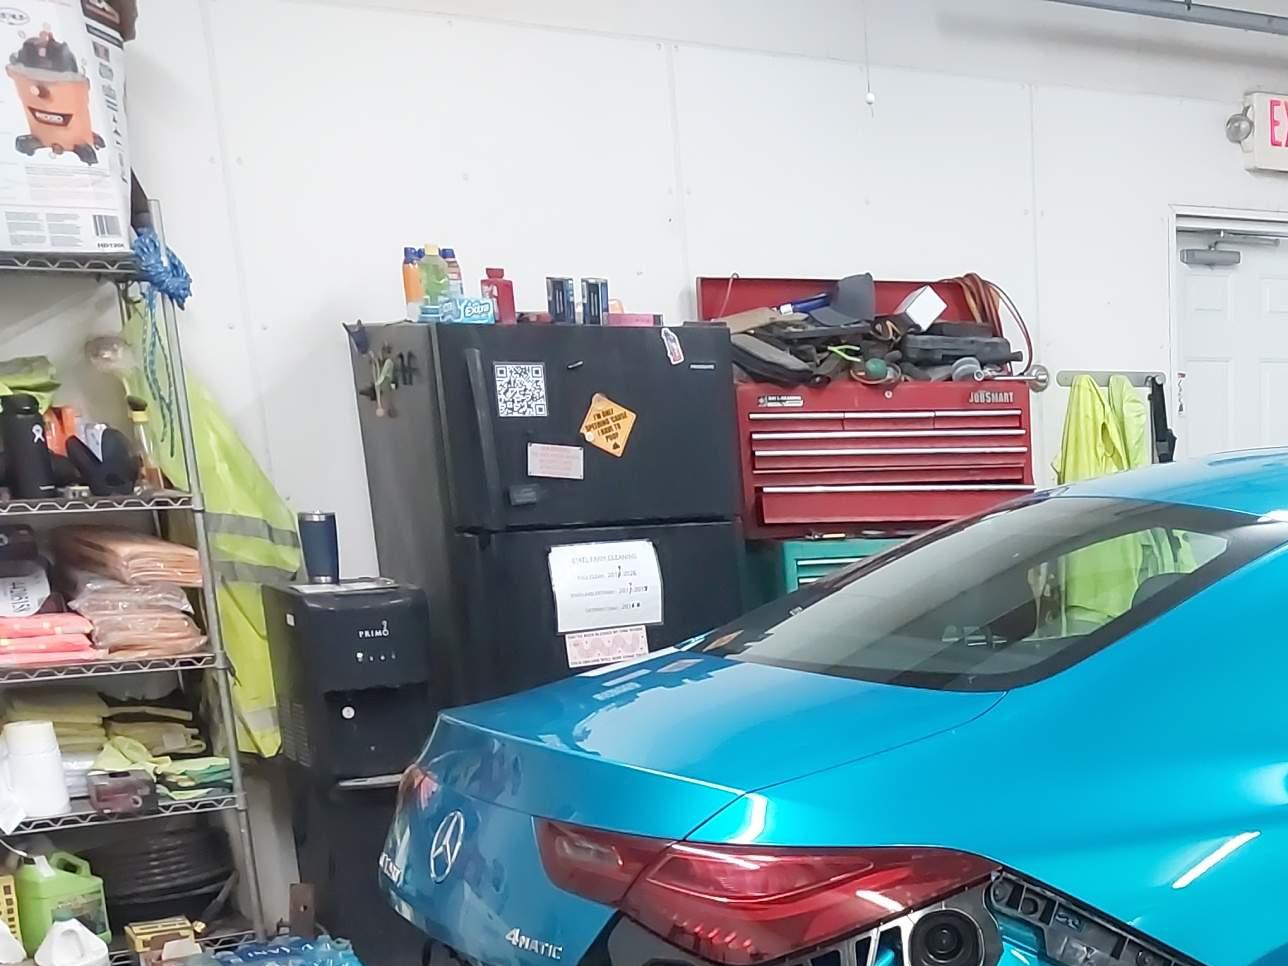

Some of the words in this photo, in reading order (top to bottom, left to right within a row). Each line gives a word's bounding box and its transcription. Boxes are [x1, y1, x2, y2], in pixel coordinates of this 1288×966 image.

[969, 391, 1014, 403] JOBSMART
[358, 622, 390, 638] PRIMO
[505, 927, 563, 960] 4MATIC
